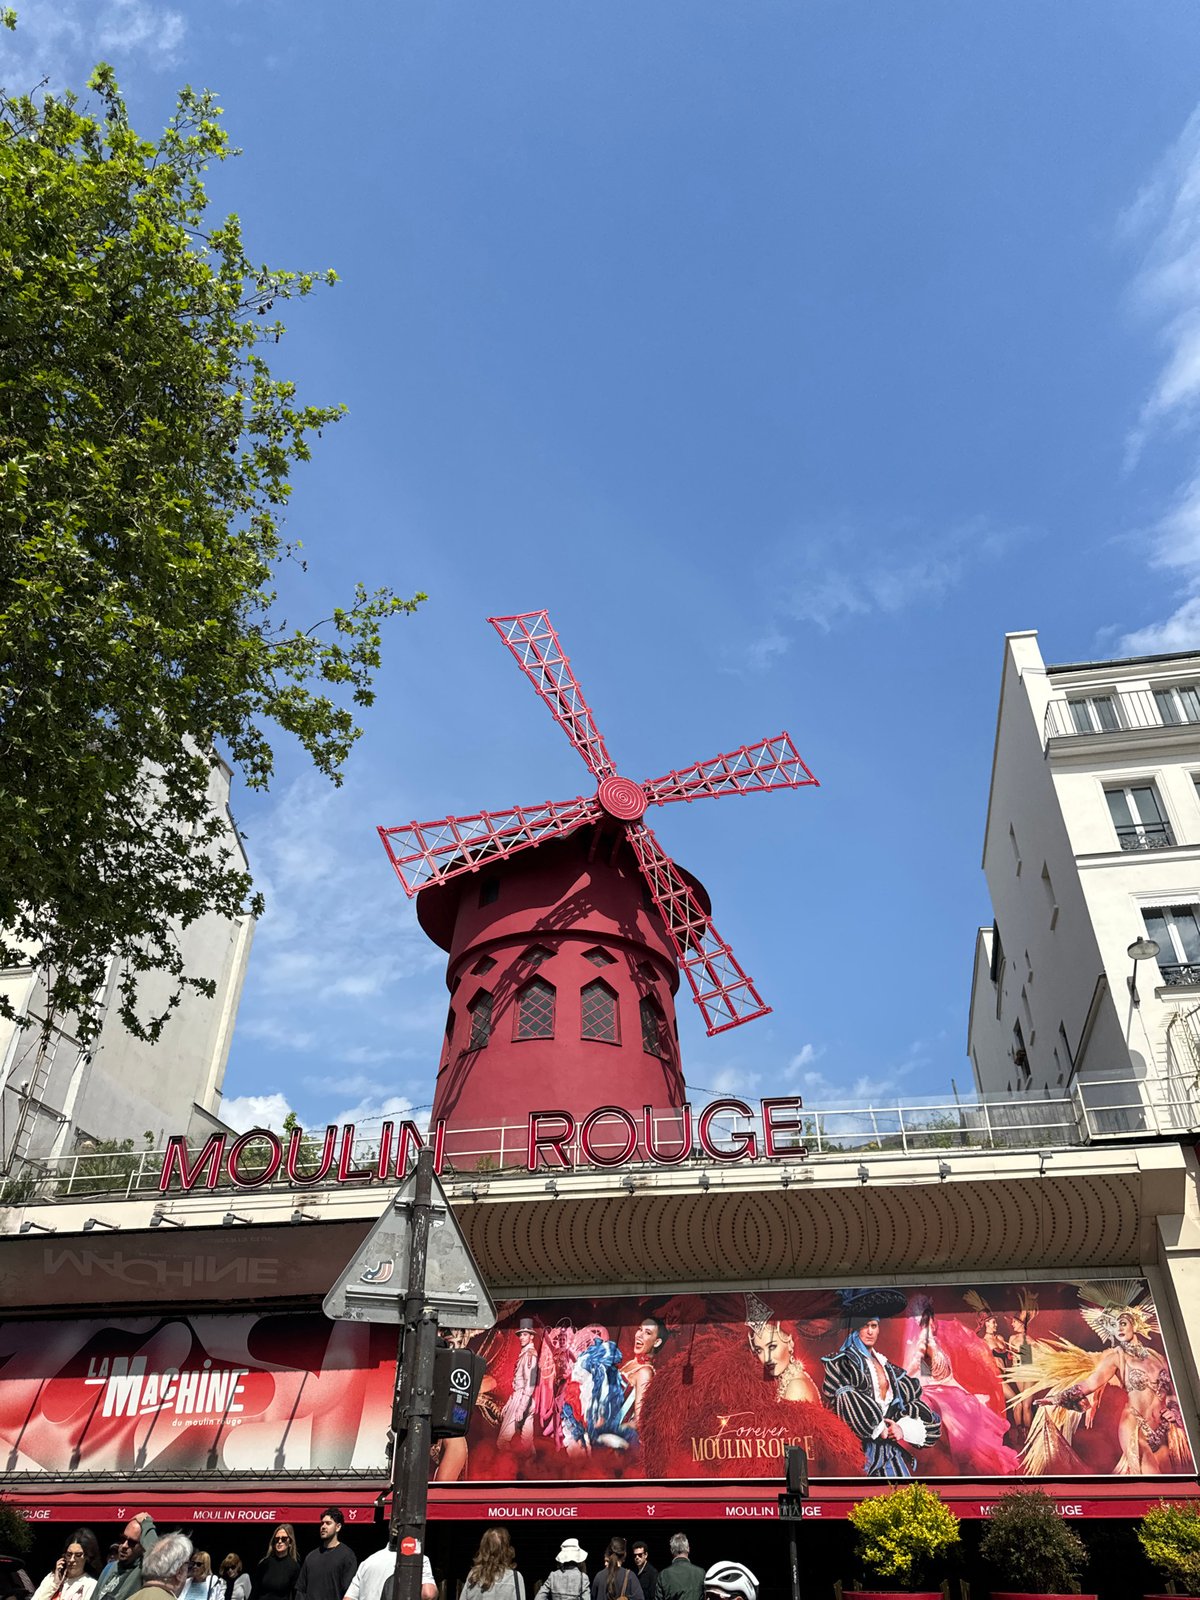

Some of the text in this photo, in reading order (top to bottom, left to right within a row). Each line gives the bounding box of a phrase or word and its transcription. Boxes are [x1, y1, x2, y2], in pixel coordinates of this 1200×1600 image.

[160, 1096, 808, 1192] MOULIN ROUGE
[87, 1357, 110, 1378] LA
[172, 1418, 182, 1427] du
[185, 1417, 214, 1427] moulin
[708, 1411, 792, 1447] Forever
[691, 1437, 752, 1462] MOULIN
[192, 1510, 277, 1520] MOULIN ROUGE
[488, 1506, 578, 1517] MOULIN ROUGE
[725, 1506, 774, 1516] MOULIN
